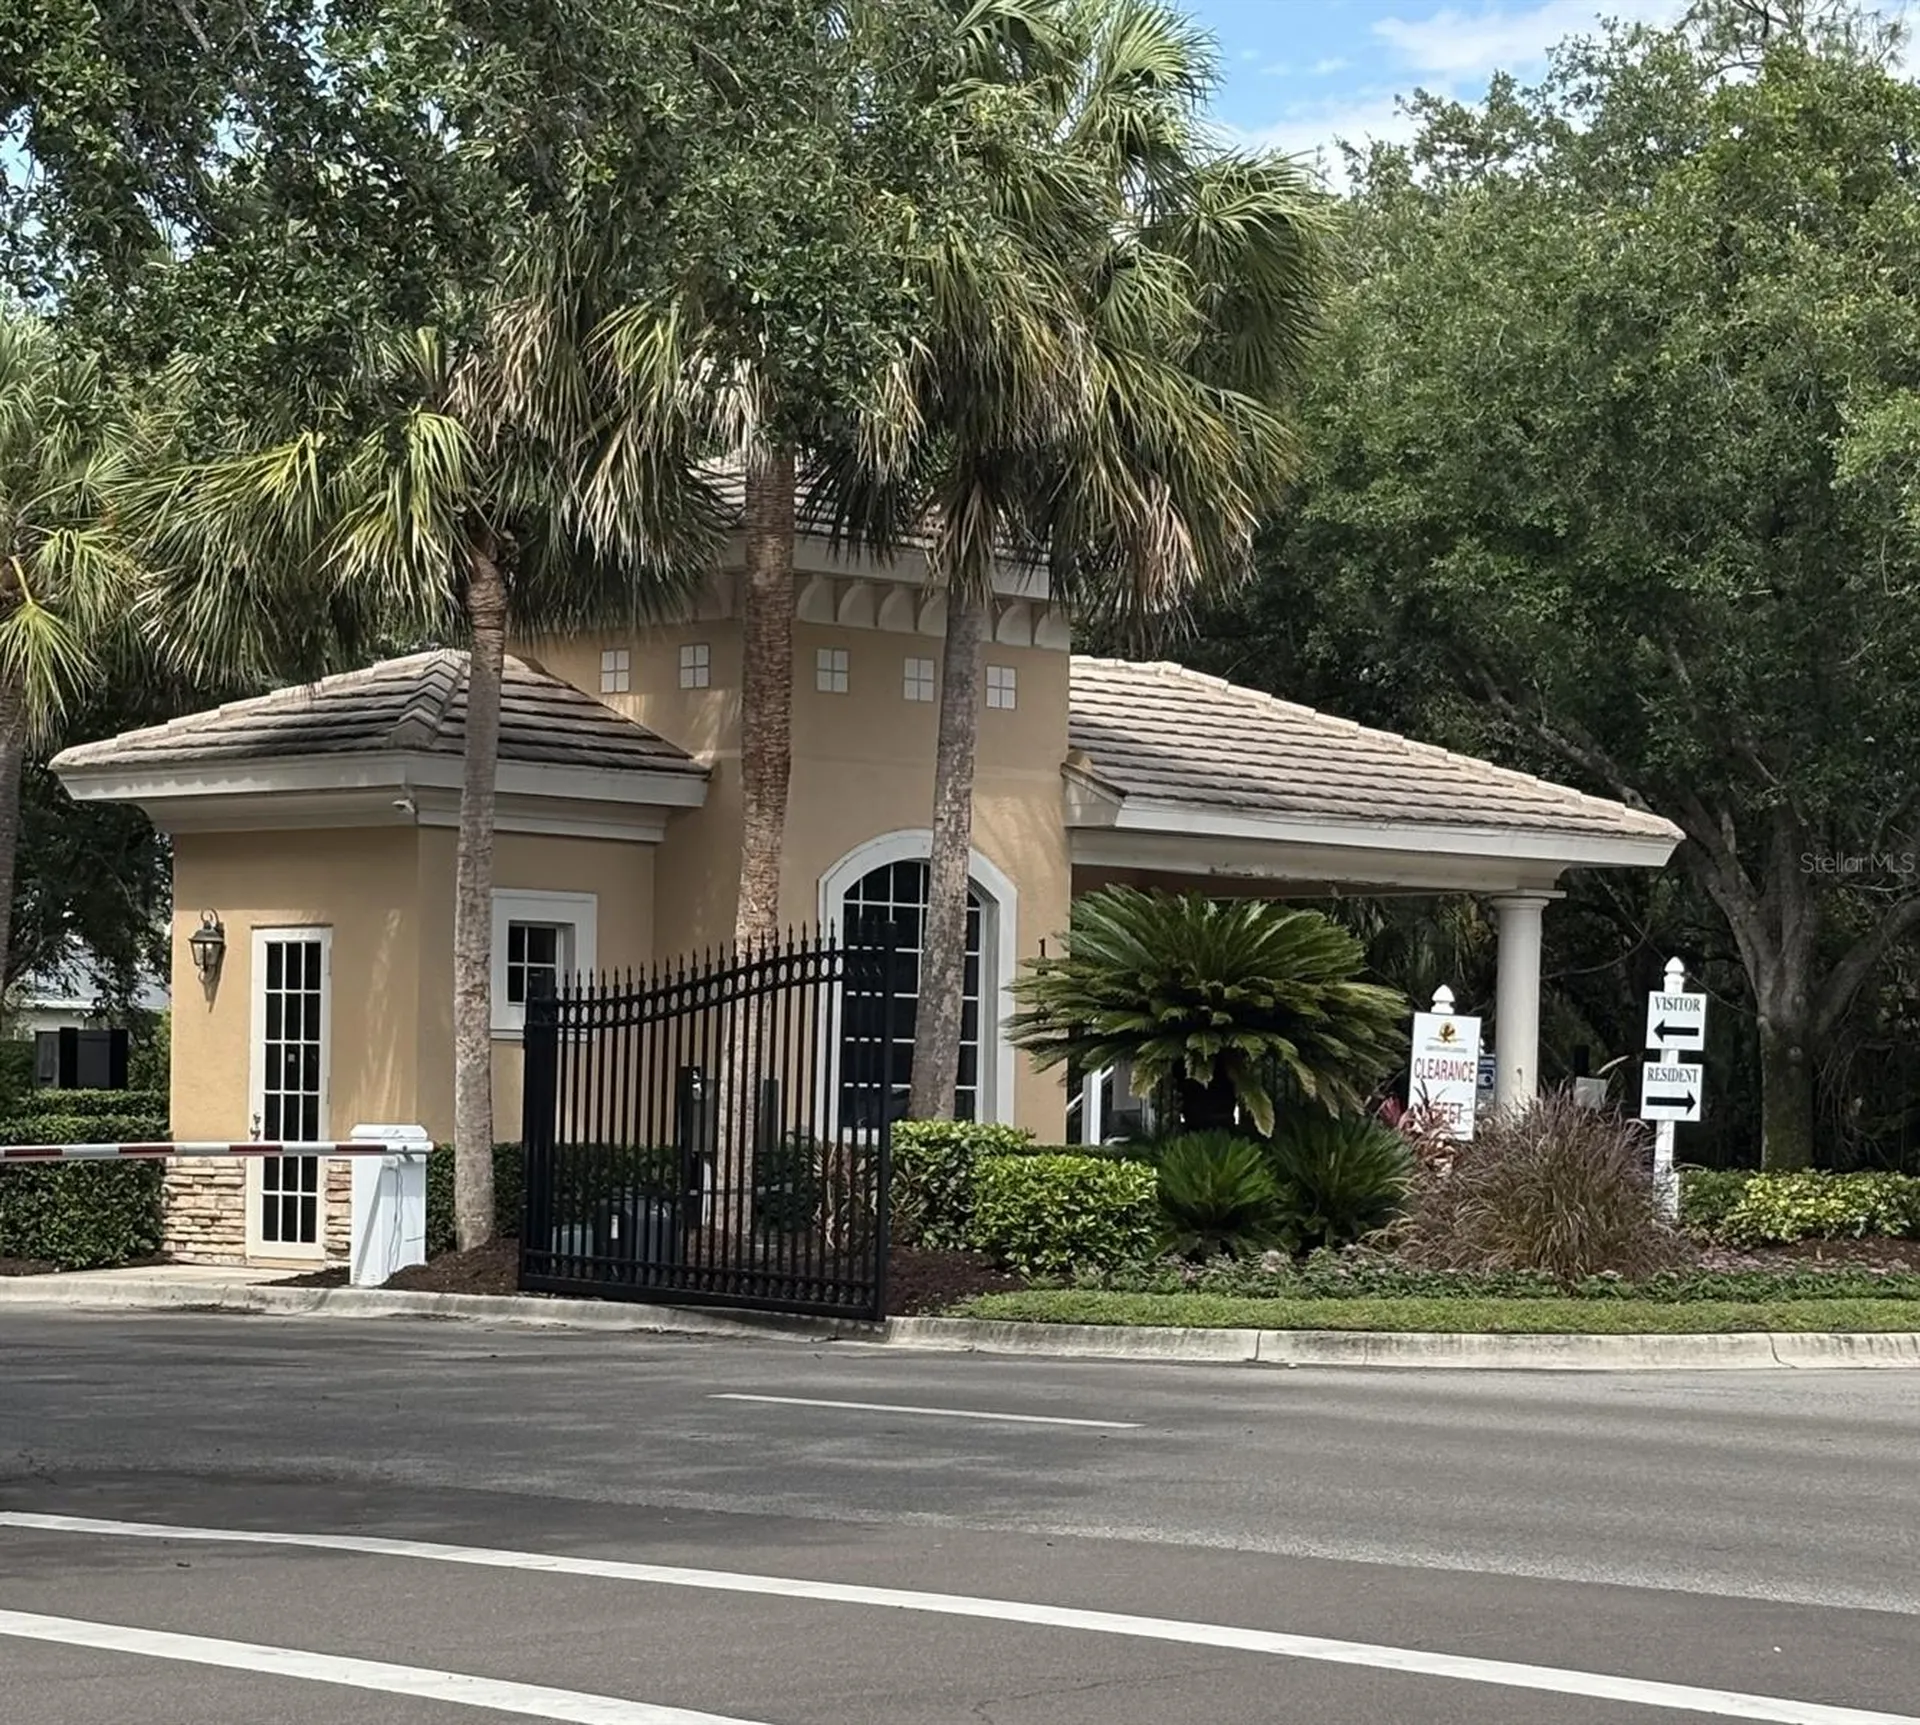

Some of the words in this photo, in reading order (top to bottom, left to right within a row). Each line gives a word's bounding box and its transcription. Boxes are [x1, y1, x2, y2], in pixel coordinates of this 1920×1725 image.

[1654, 996, 1701, 1012] VISITOR
[1414, 1057, 1475, 1083] CLEARANCE
[1647, 1067, 1698, 1083] RESIDENT
